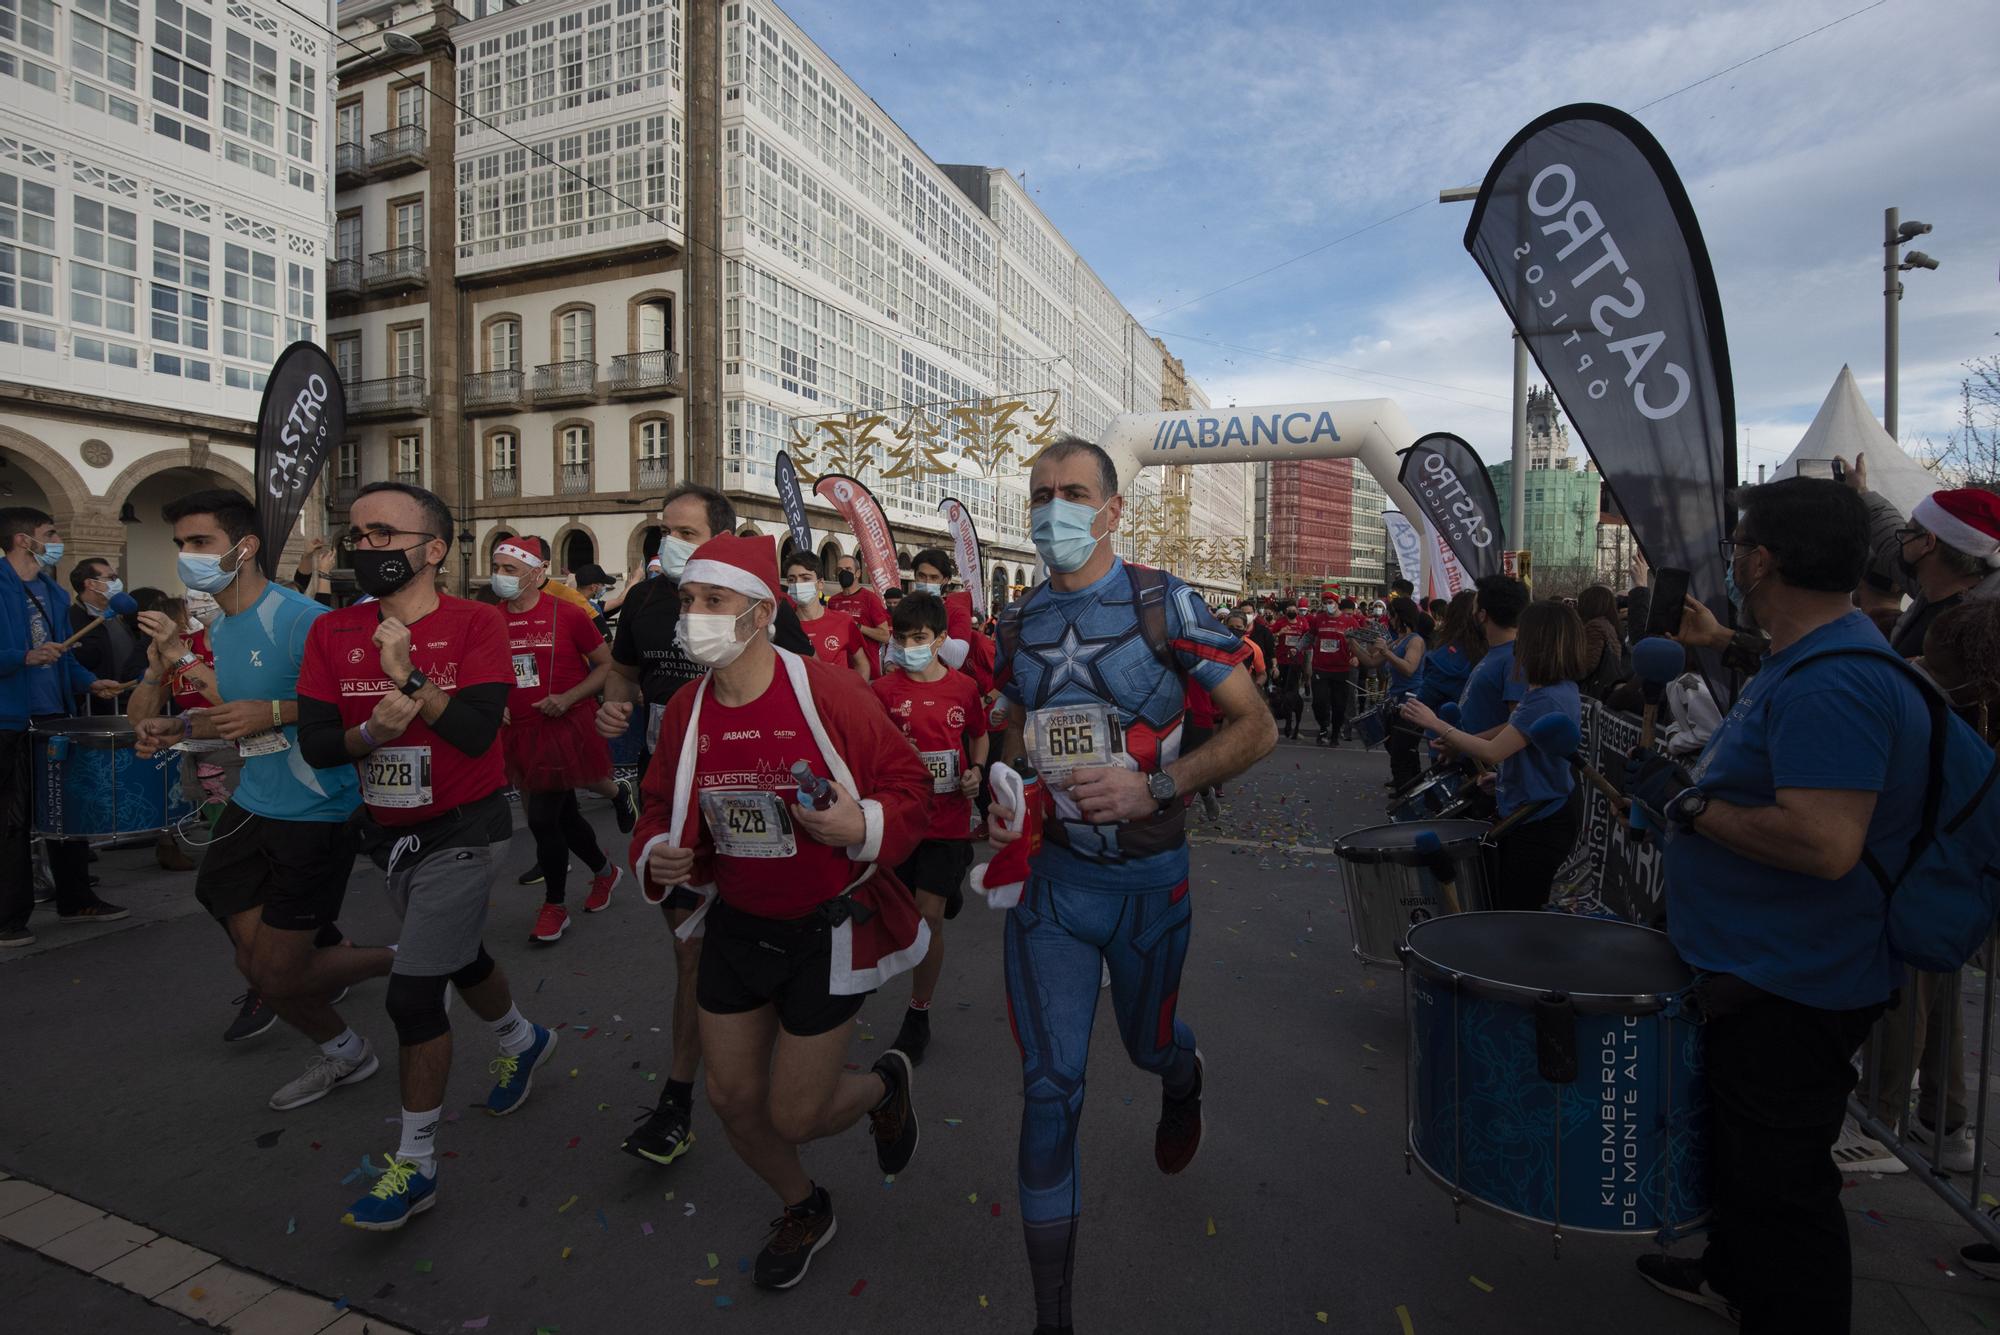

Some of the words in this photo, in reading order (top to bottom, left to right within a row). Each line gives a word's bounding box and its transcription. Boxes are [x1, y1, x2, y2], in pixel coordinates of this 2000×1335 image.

[268, 372, 329, 500] CASTRO
[643, 649, 676, 660] MEDIA
[659, 660, 709, 674] SOLIDARI
[1050, 714, 1090, 727] XERION
[1049, 726, 1094, 756] 665
[367, 763, 412, 786] 3228
[729, 808, 767, 833] 428
[1601, 1031, 1616, 1207] KILOMBEROS
[1623, 1094, 1637, 1184] MONTE
[1623, 1192, 1637, 1226] DE
